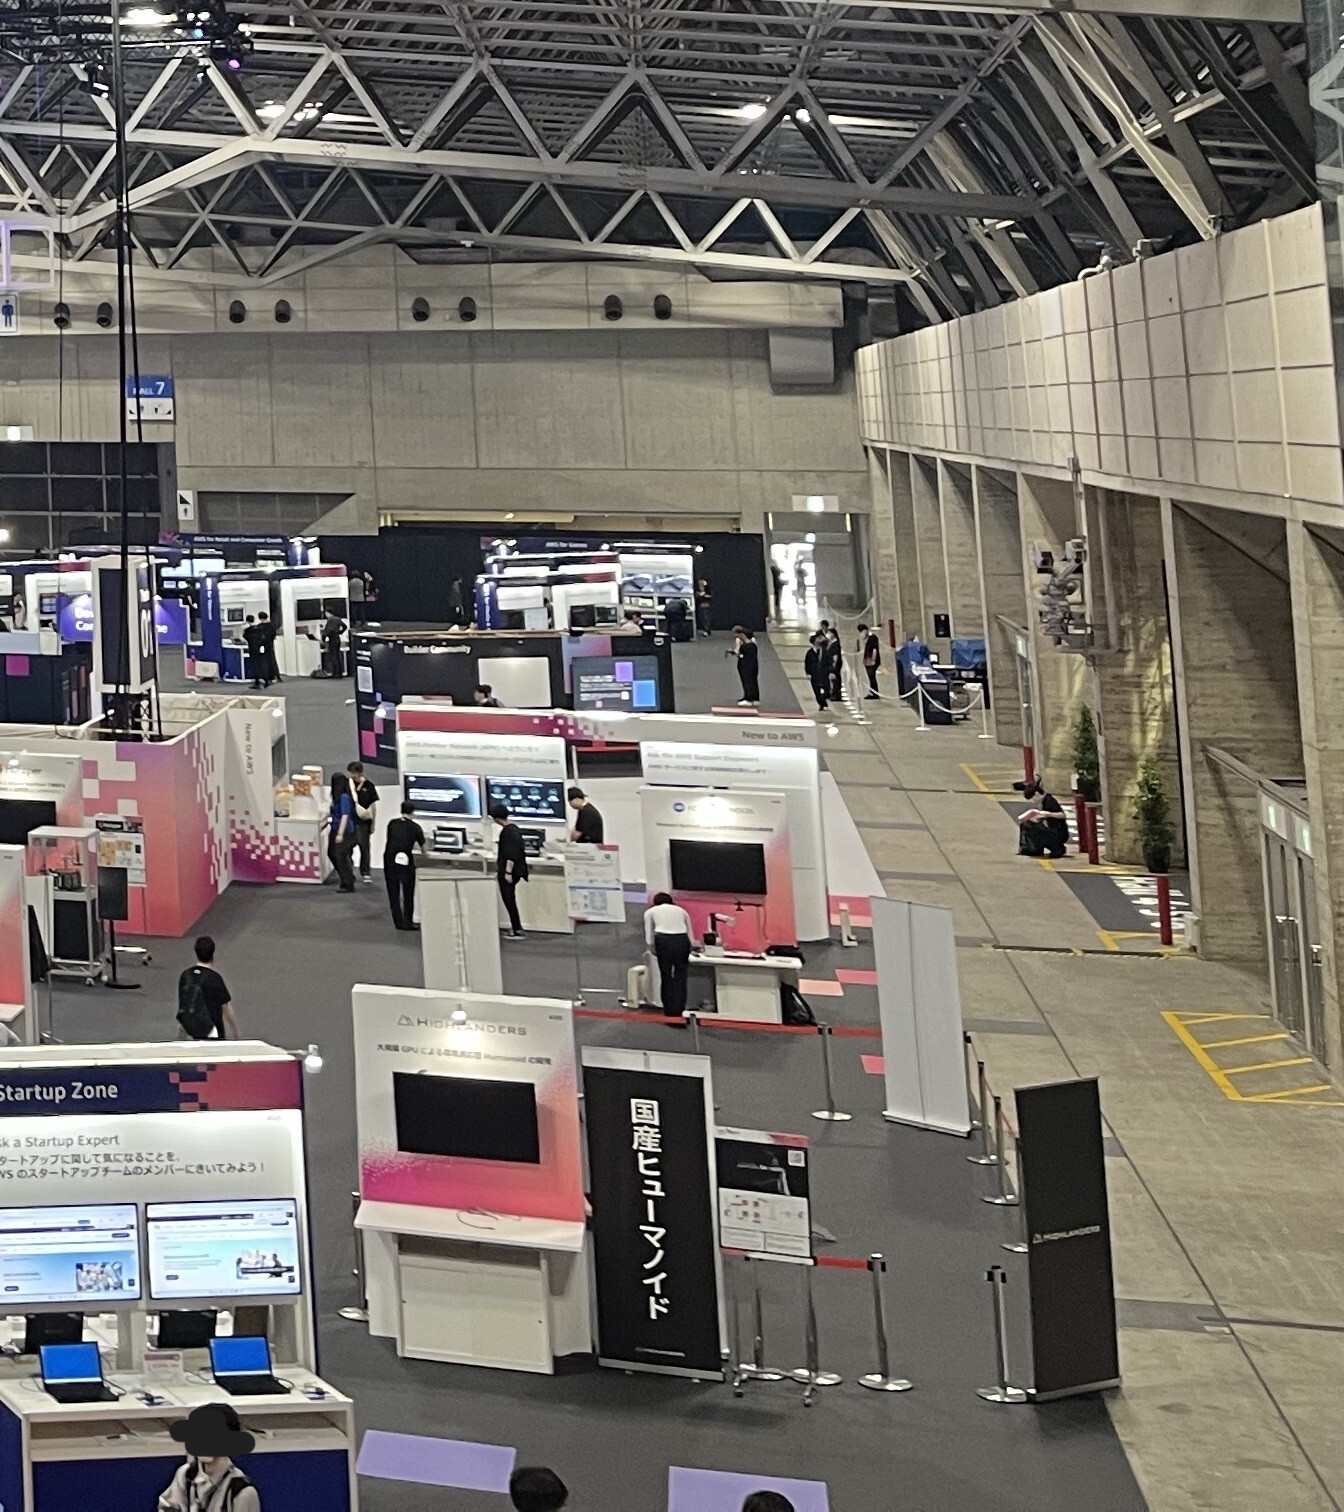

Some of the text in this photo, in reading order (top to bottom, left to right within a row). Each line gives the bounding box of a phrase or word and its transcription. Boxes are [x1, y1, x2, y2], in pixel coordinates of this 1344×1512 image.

[155, 381, 166, 396] 7
[742, 730, 805, 742] New to AWS
[70, 1081, 119, 1101] Zone
[13, 1139, 21, 1149] a
[25, 1136, 74, 1150] Startup
[77, 1134, 120, 1149] Expert
[630, 1098, 670, 1320] 国産ヒューマノイド
